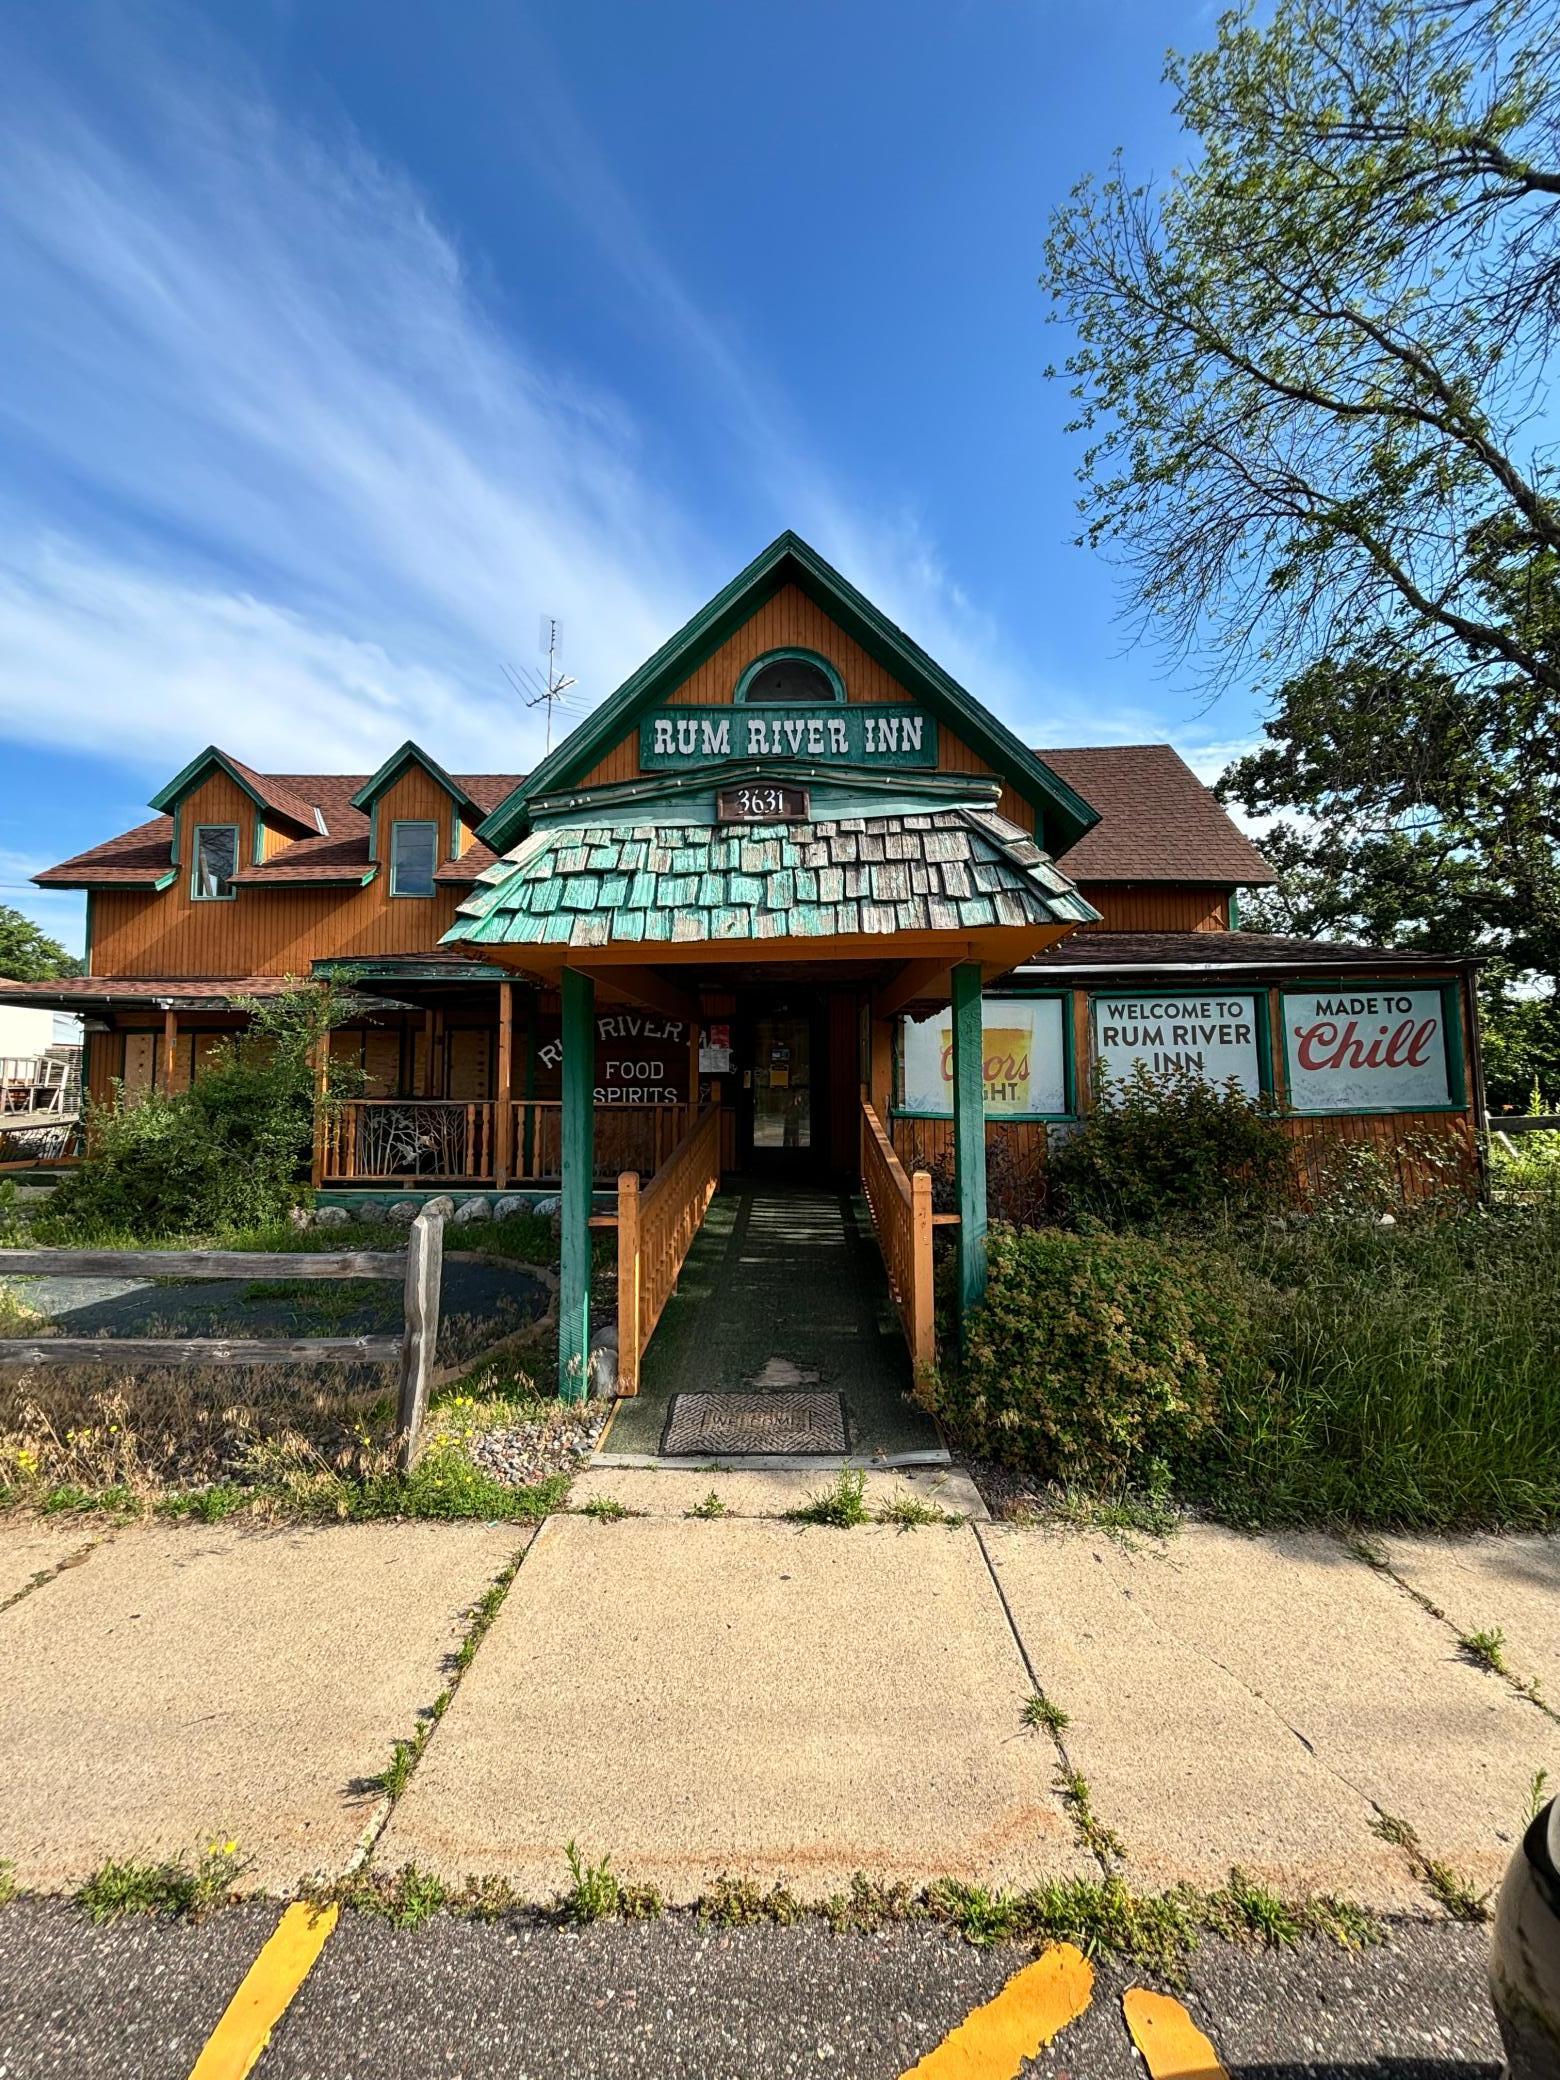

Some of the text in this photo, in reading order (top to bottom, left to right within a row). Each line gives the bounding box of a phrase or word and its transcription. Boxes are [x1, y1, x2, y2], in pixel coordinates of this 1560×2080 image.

[655, 716, 923, 754] RUM RIVER INN
[736, 790, 785, 815] 3631
[1108, 1002, 1243, 1020] WELCOME TO
[1316, 997, 1413, 1016] MADE TO
[597, 1016, 684, 1041] RIVER
[1103, 1023, 1252, 1047] RUM RIVER
[1294, 1019, 1437, 1071] Chill
[605, 1062, 664, 1079] FOOD
[940, 1044, 1031, 1082] Cors
[1153, 1051, 1203, 1073] INN
[592, 1087, 678, 1104] SPIRITS
